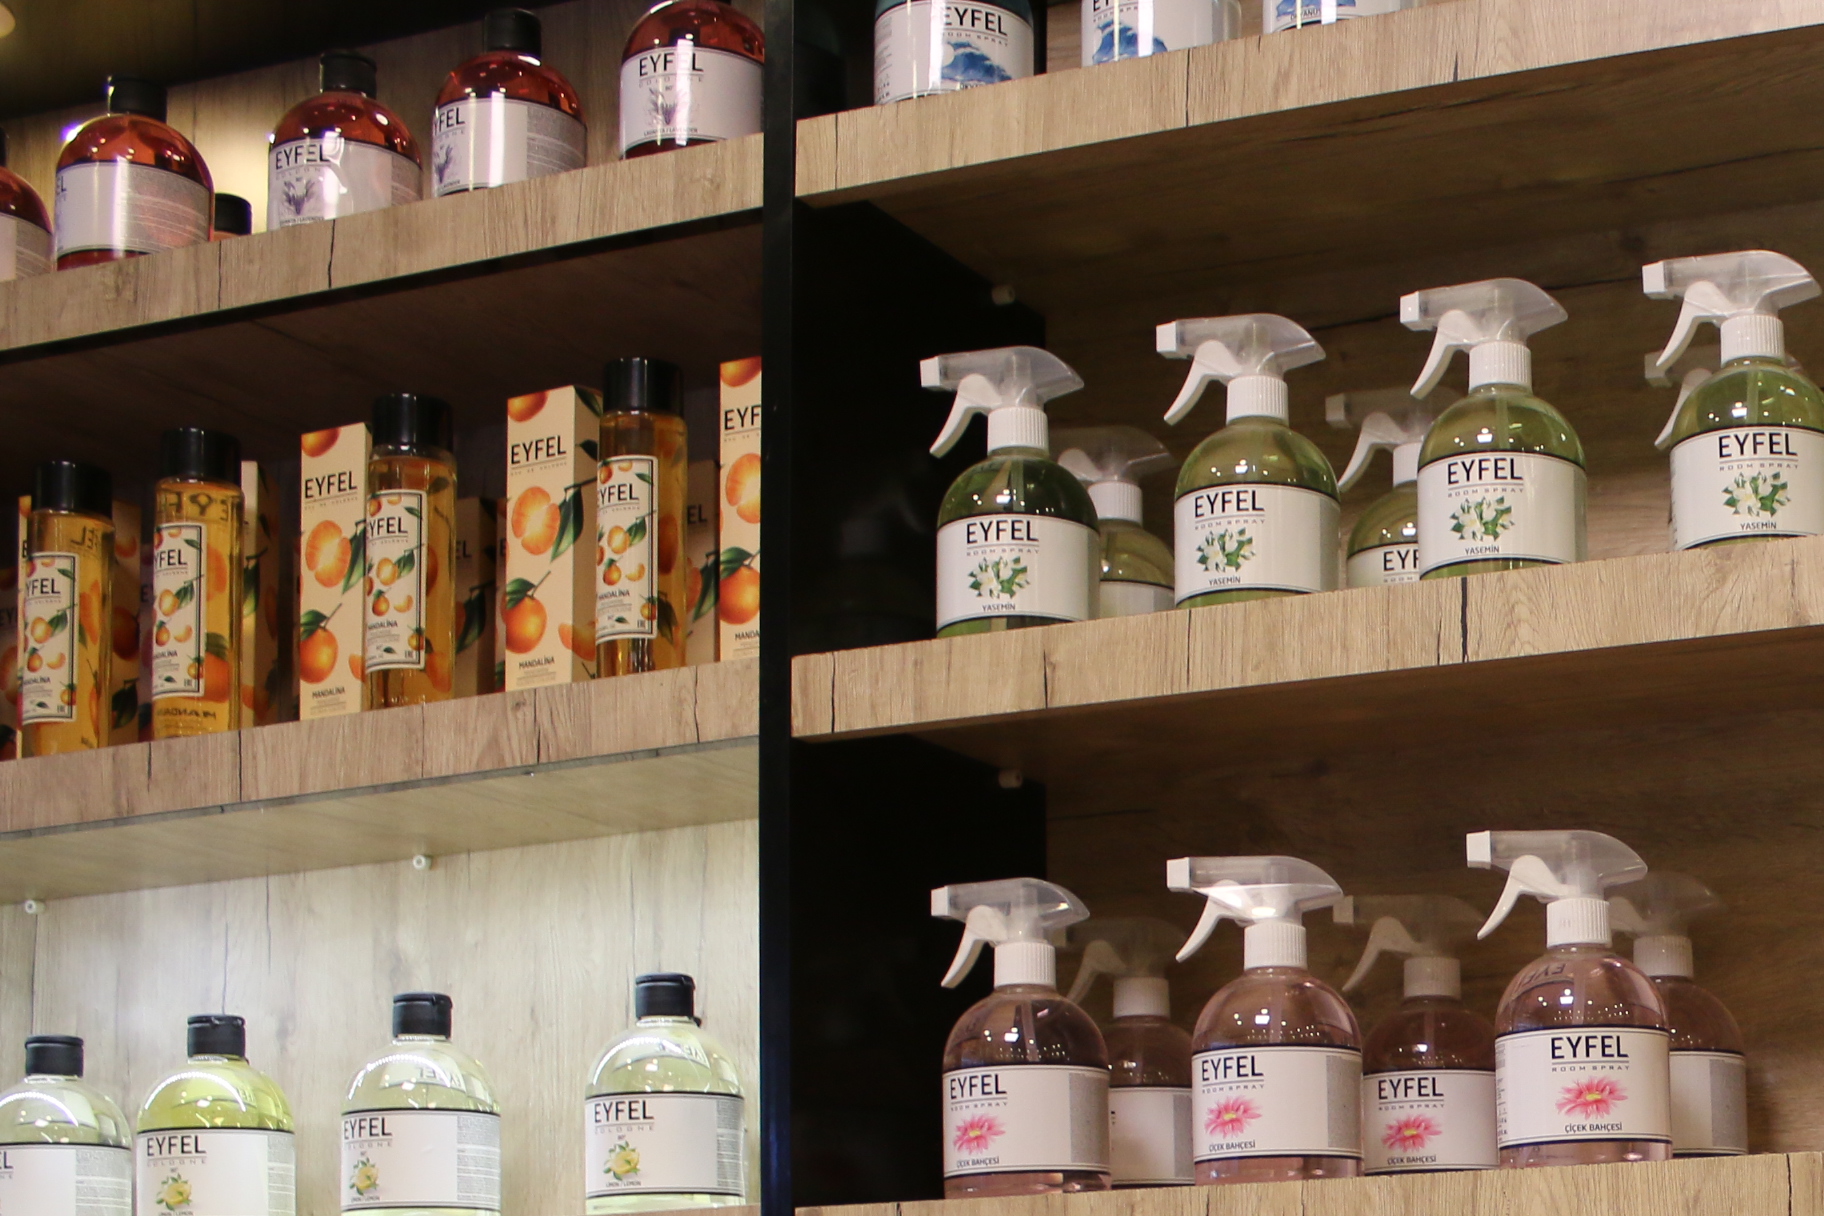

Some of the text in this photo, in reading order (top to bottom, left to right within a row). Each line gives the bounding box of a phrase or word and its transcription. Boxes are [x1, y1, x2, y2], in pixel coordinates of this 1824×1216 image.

[639, 52, 704, 77] EYFL
[724, 404, 761, 431] EYF
[511, 435, 566, 465] EYFEL
[1718, 432, 1798, 459] EYFEL
[1447, 458, 1524, 485] EYFEL
[305, 470, 358, 500] EYFEL
[599, 483, 639, 506] YFEL
[1194, 490, 1265, 518] EYFEL
[368, 515, 408, 538] YFEL
[966, 520, 1039, 545] EYFEL
[1740, 520, 1777, 531] YASEMİN
[153, 548, 188, 567] YFEL
[1383, 549, 1418, 572] EYF
[1465, 544, 1500, 556] YASEMİN
[25, 577, 61, 597] YFEL
[1208, 575, 1241, 586] YASEMİN
[982, 602, 1016, 612] YASEMİN
[1551, 1035, 1629, 1060] EYFEL
[1201, 1055, 1264, 1082] EYFEL
[950, 1073, 1007, 1100] EYFEL
[1378, 1077, 1444, 1100] EYFEL
[594, 1100, 654, 1124] EYFEL
[343, 1117, 392, 1140] EYFEL
[147, 1135, 207, 1157] EYFEL
